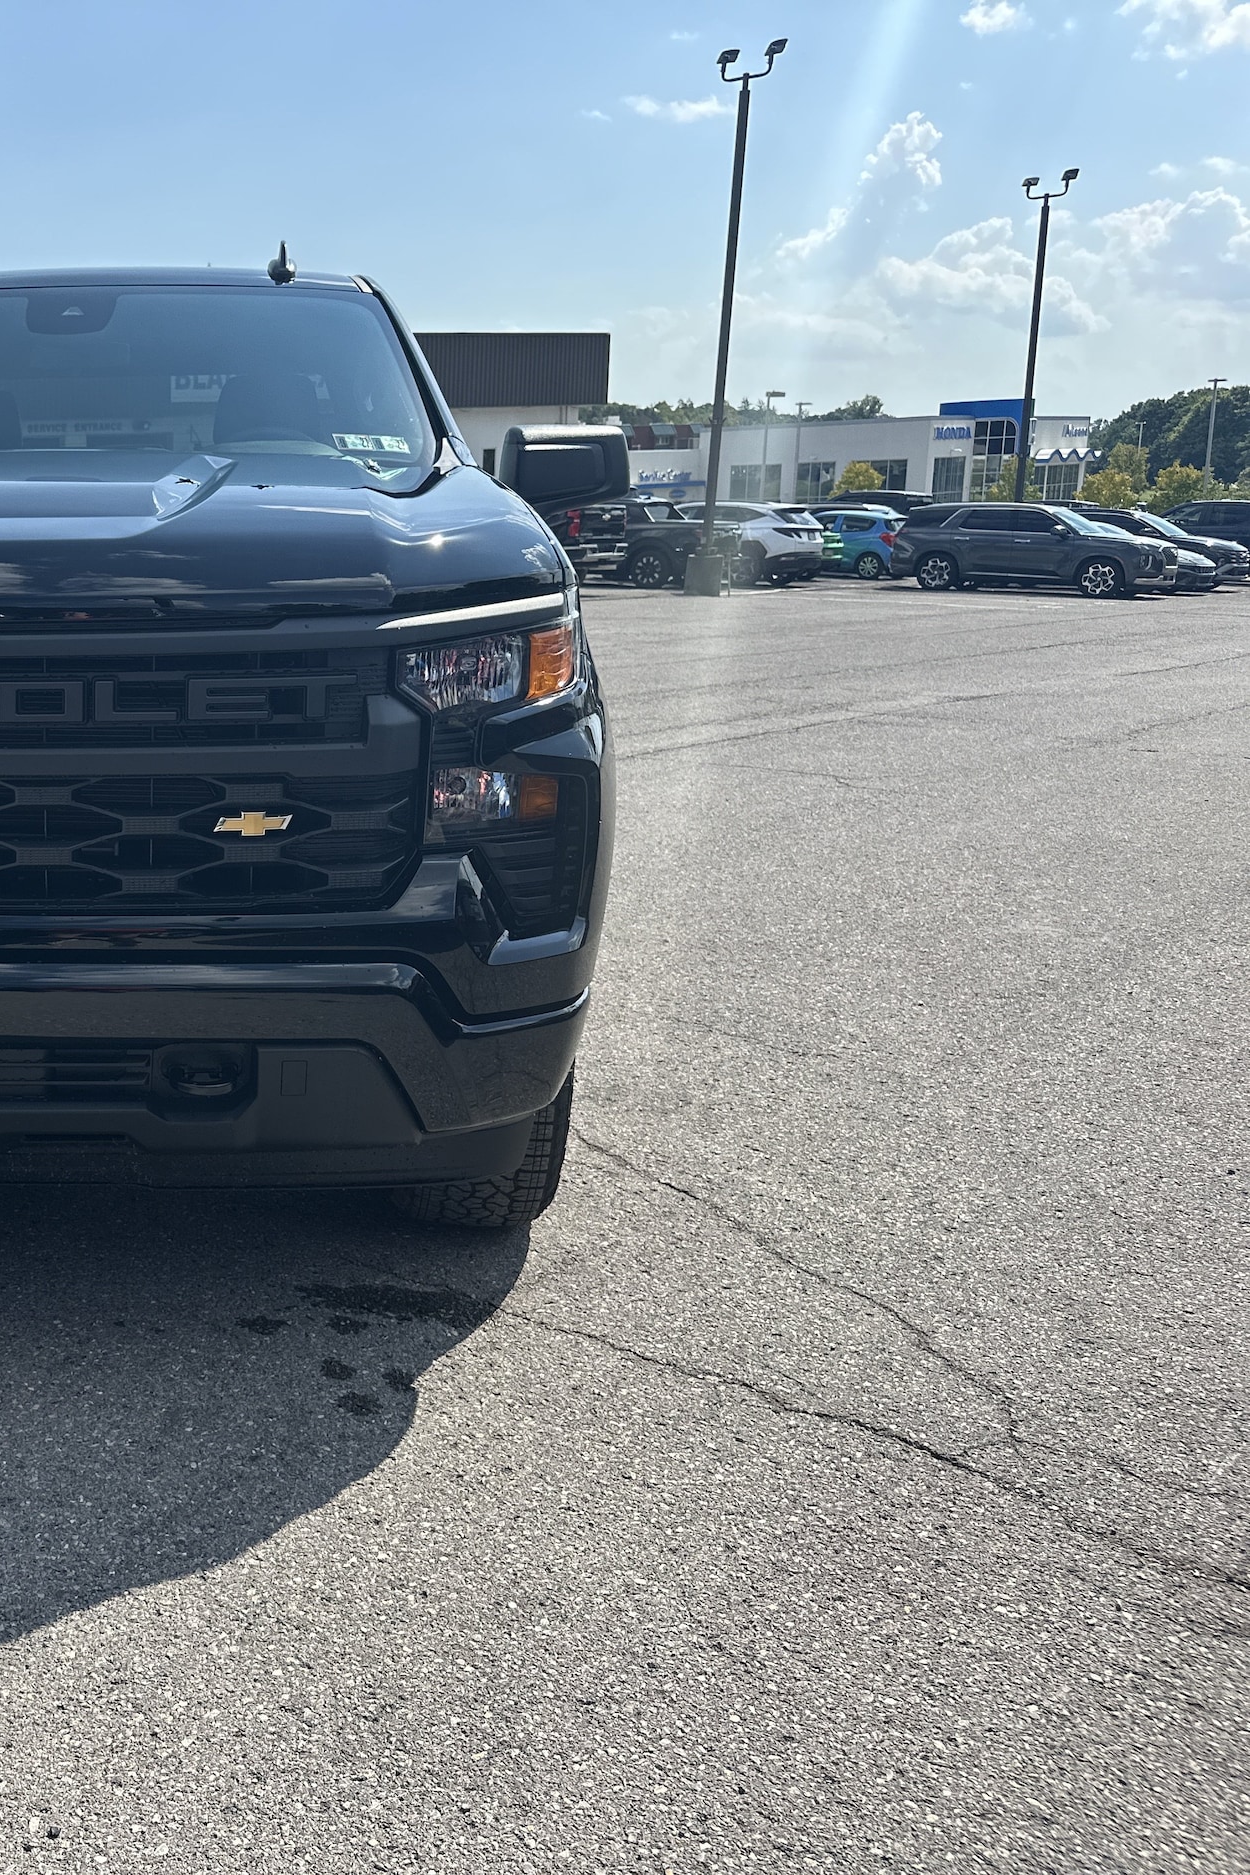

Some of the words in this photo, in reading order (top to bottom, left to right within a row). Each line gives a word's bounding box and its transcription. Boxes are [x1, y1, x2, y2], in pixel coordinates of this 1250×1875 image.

[27, 423, 67, 434] SERVICE
[73, 422, 123, 433] ENTRANCE
[934, 425, 972, 440] HONDA
